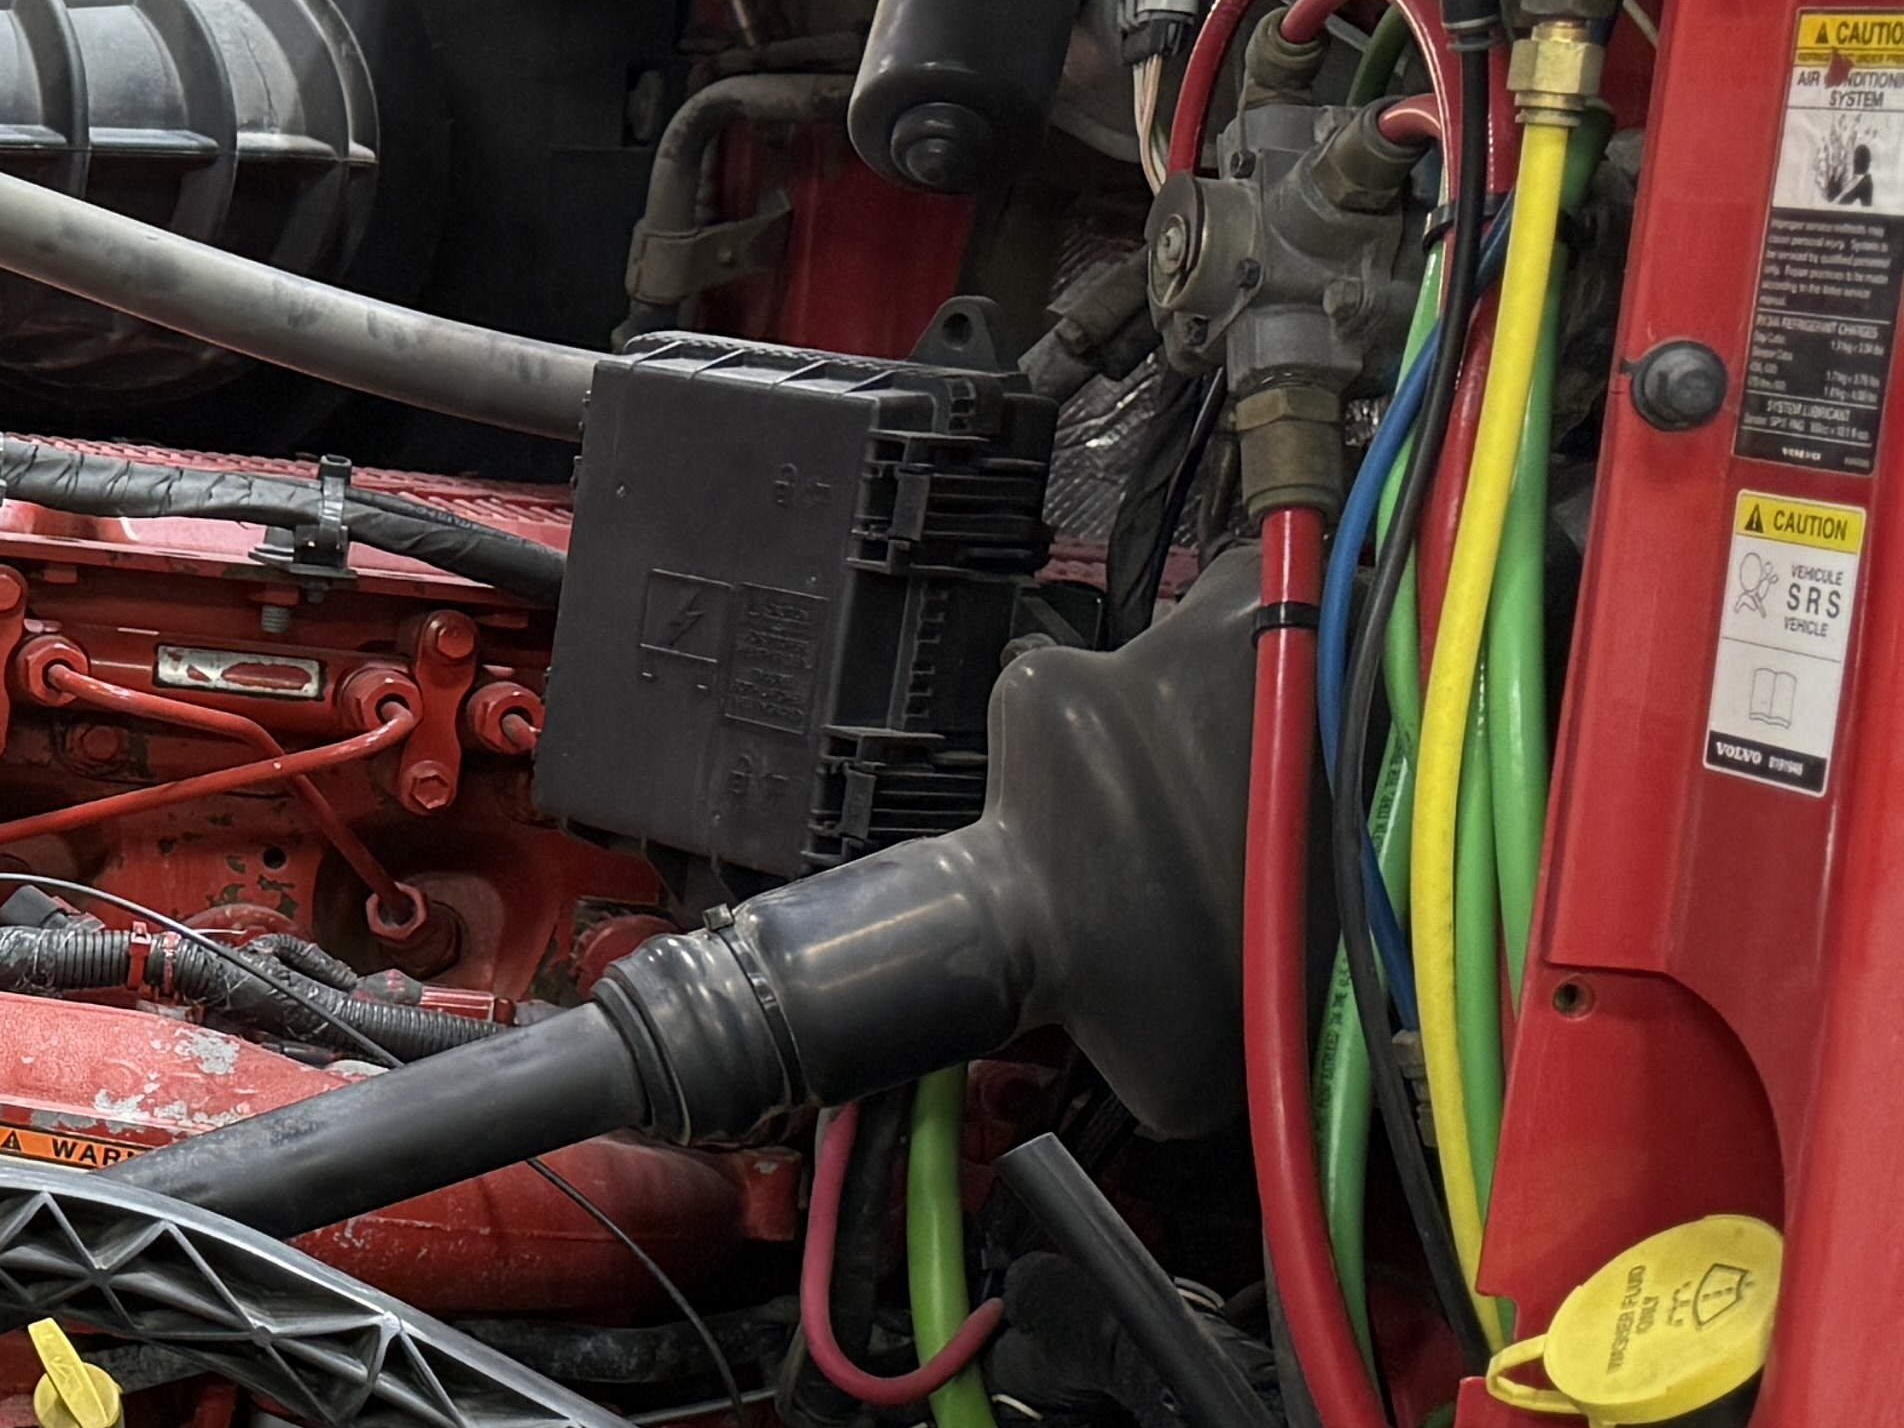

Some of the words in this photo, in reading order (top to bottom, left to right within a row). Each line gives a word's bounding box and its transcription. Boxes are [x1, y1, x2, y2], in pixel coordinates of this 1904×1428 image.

[1797, 71, 1821, 87] AIR
[1829, 90, 1884, 107] SYSTEM
[1773, 510, 1848, 541] CAUTION
[1792, 564, 1844, 586] VEHICULE
[1784, 616, 1829, 638] VEHICLE
[1716, 741, 1762, 765] VOLVO
[52, 1138, 135, 1166] WAR
